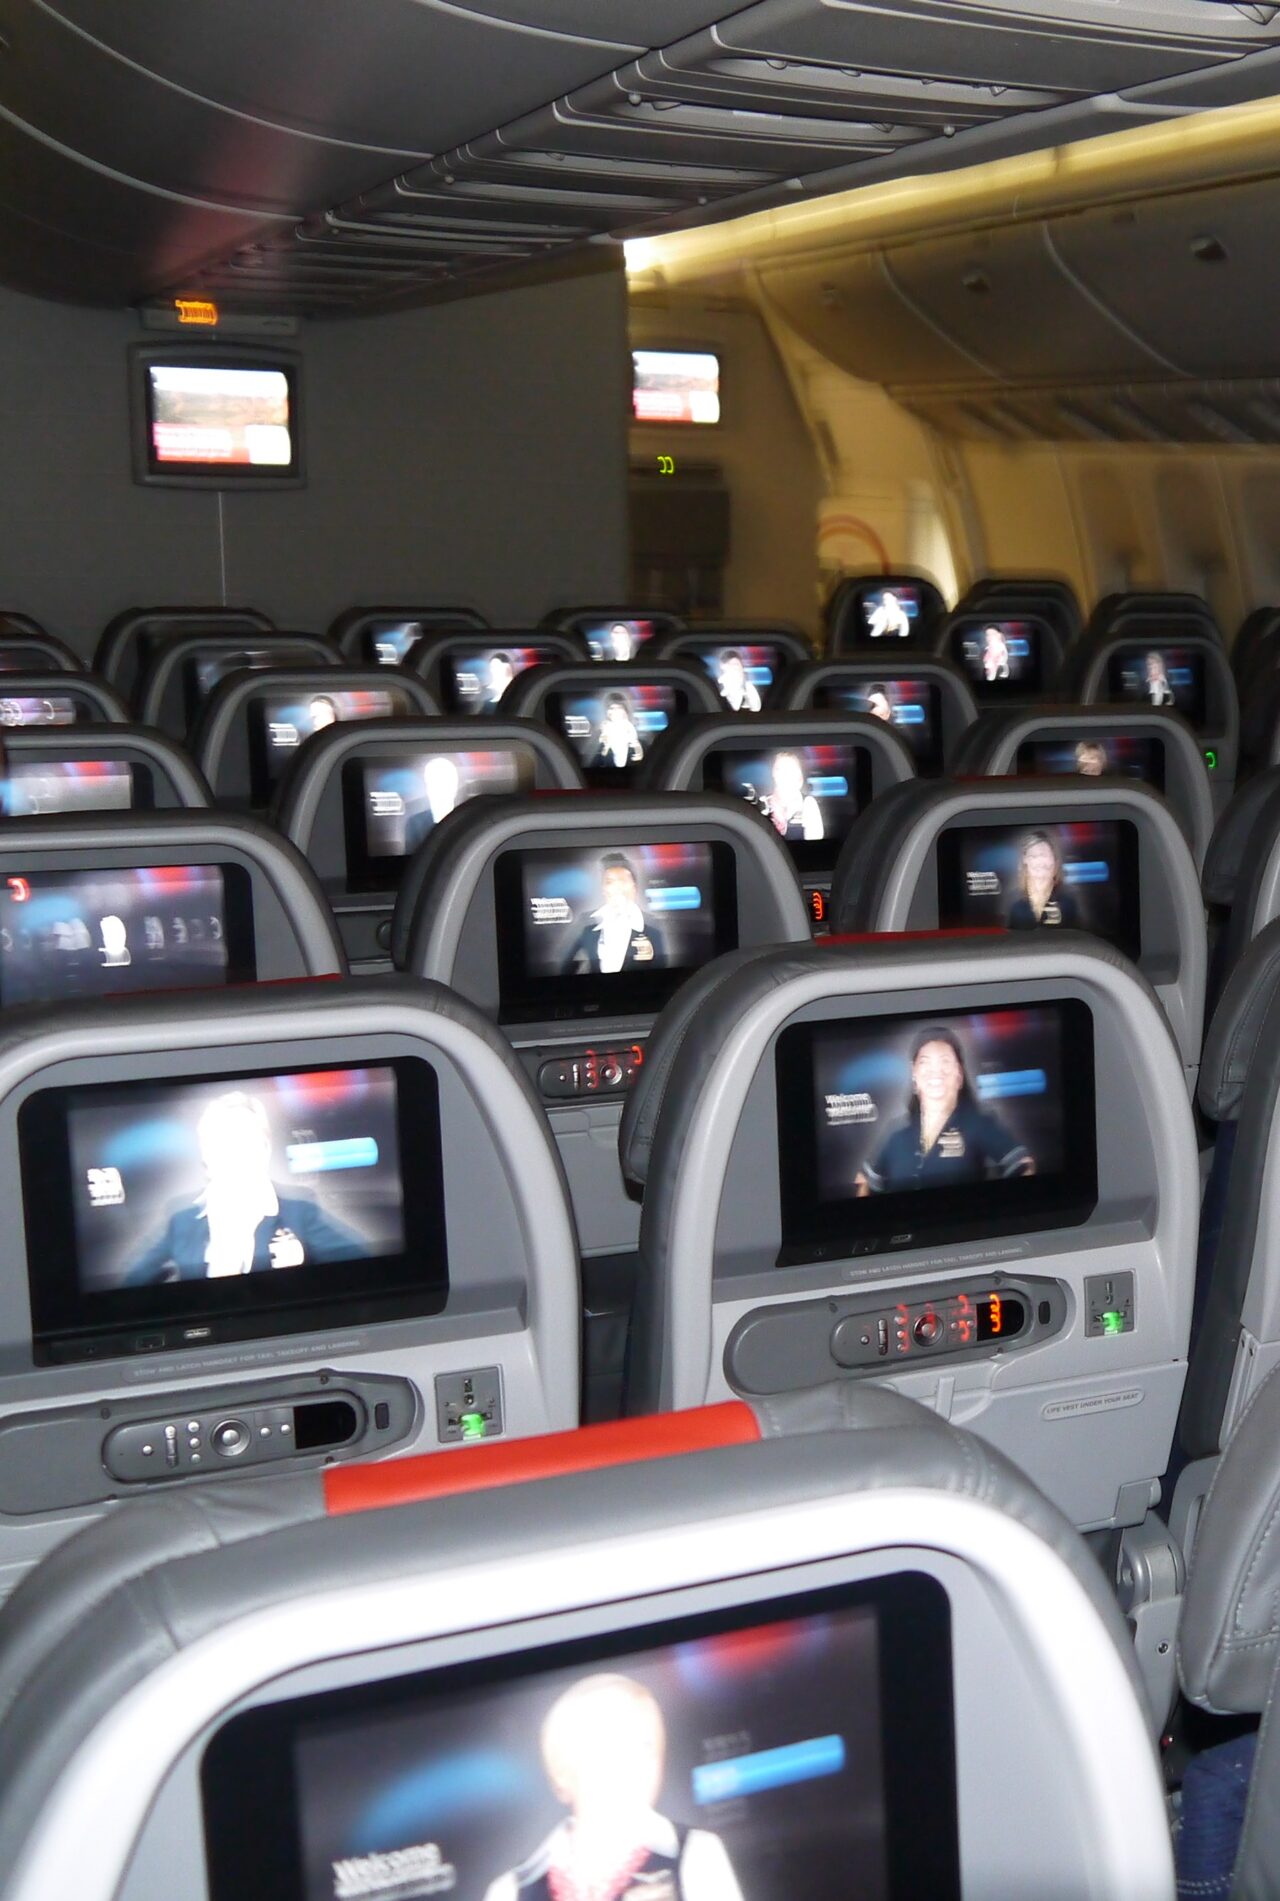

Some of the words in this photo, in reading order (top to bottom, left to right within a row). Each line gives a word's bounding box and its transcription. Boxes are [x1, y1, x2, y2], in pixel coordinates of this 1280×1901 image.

[1080, 1400, 1103, 1409] UNDER
[1103, 1396, 1121, 1405] YOUR
[331, 1842, 442, 1884] Welcome
